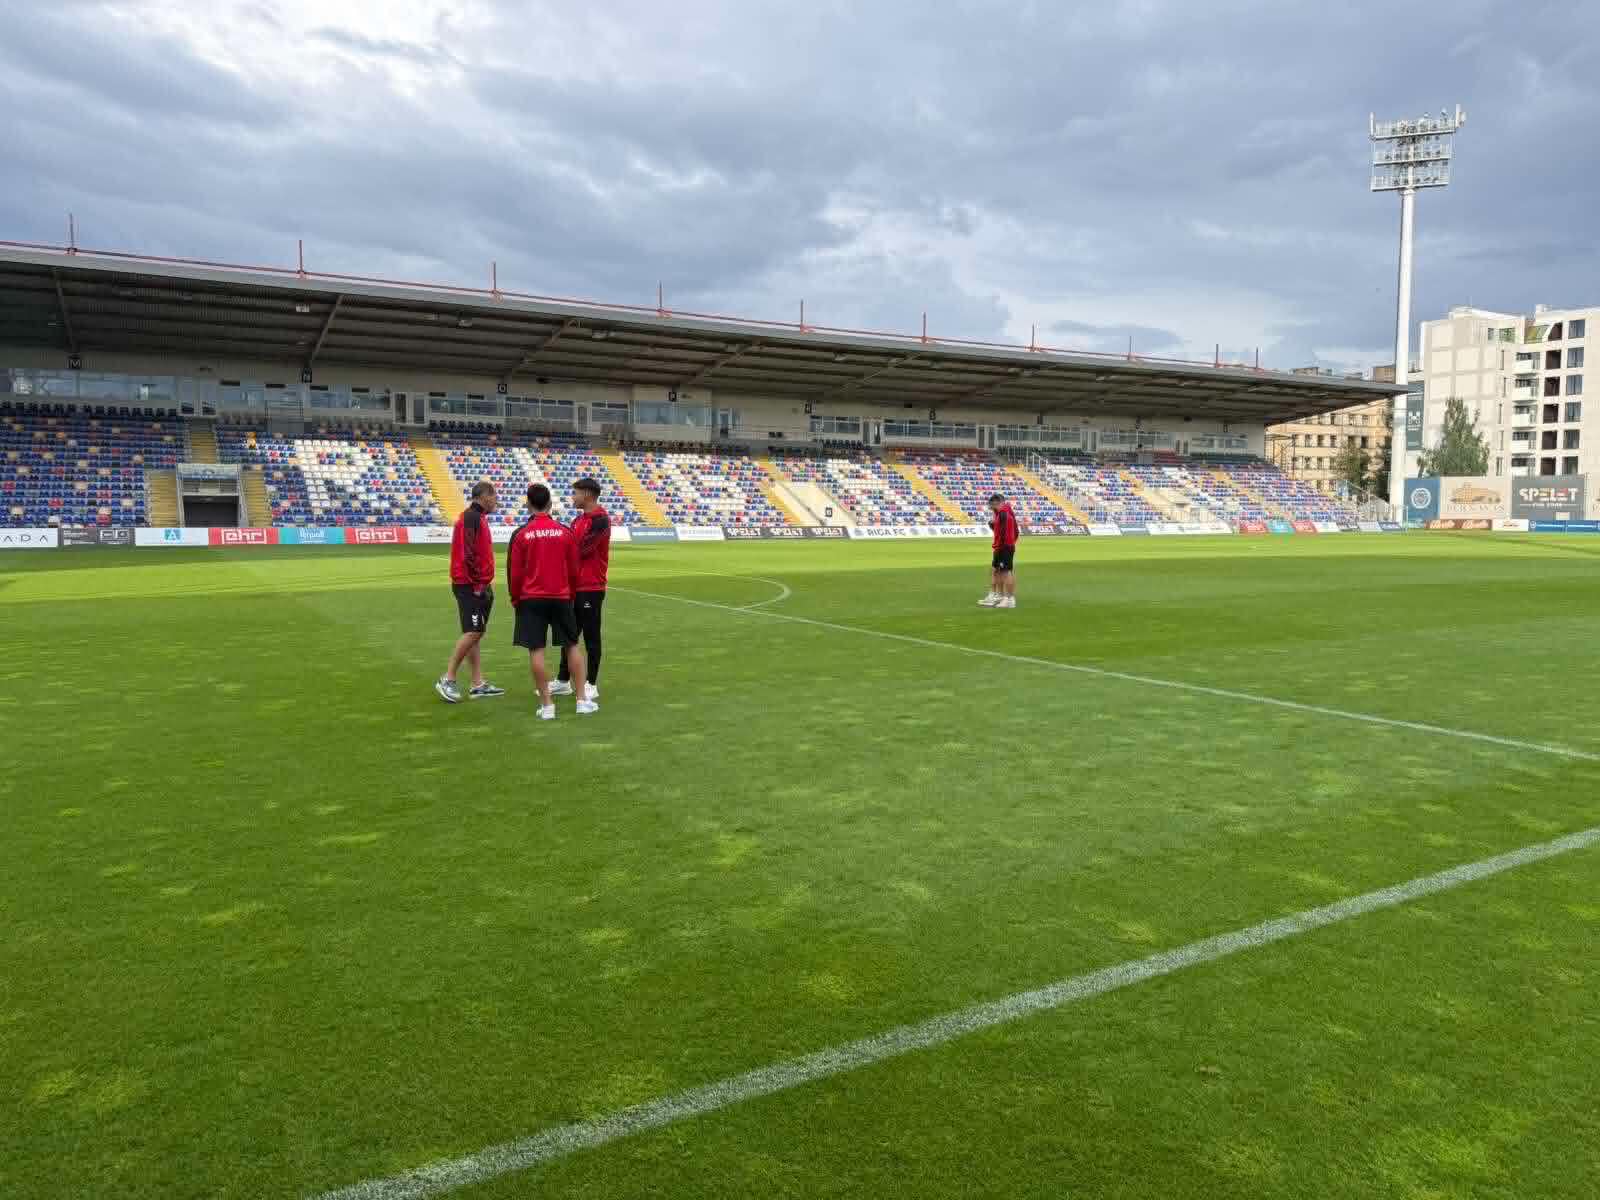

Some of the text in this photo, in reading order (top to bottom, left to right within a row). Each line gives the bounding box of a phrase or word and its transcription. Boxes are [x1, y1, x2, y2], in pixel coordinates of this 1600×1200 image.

[867, 528, 905, 536] RIGA FC
[940, 527, 977, 536] RIGA FC
